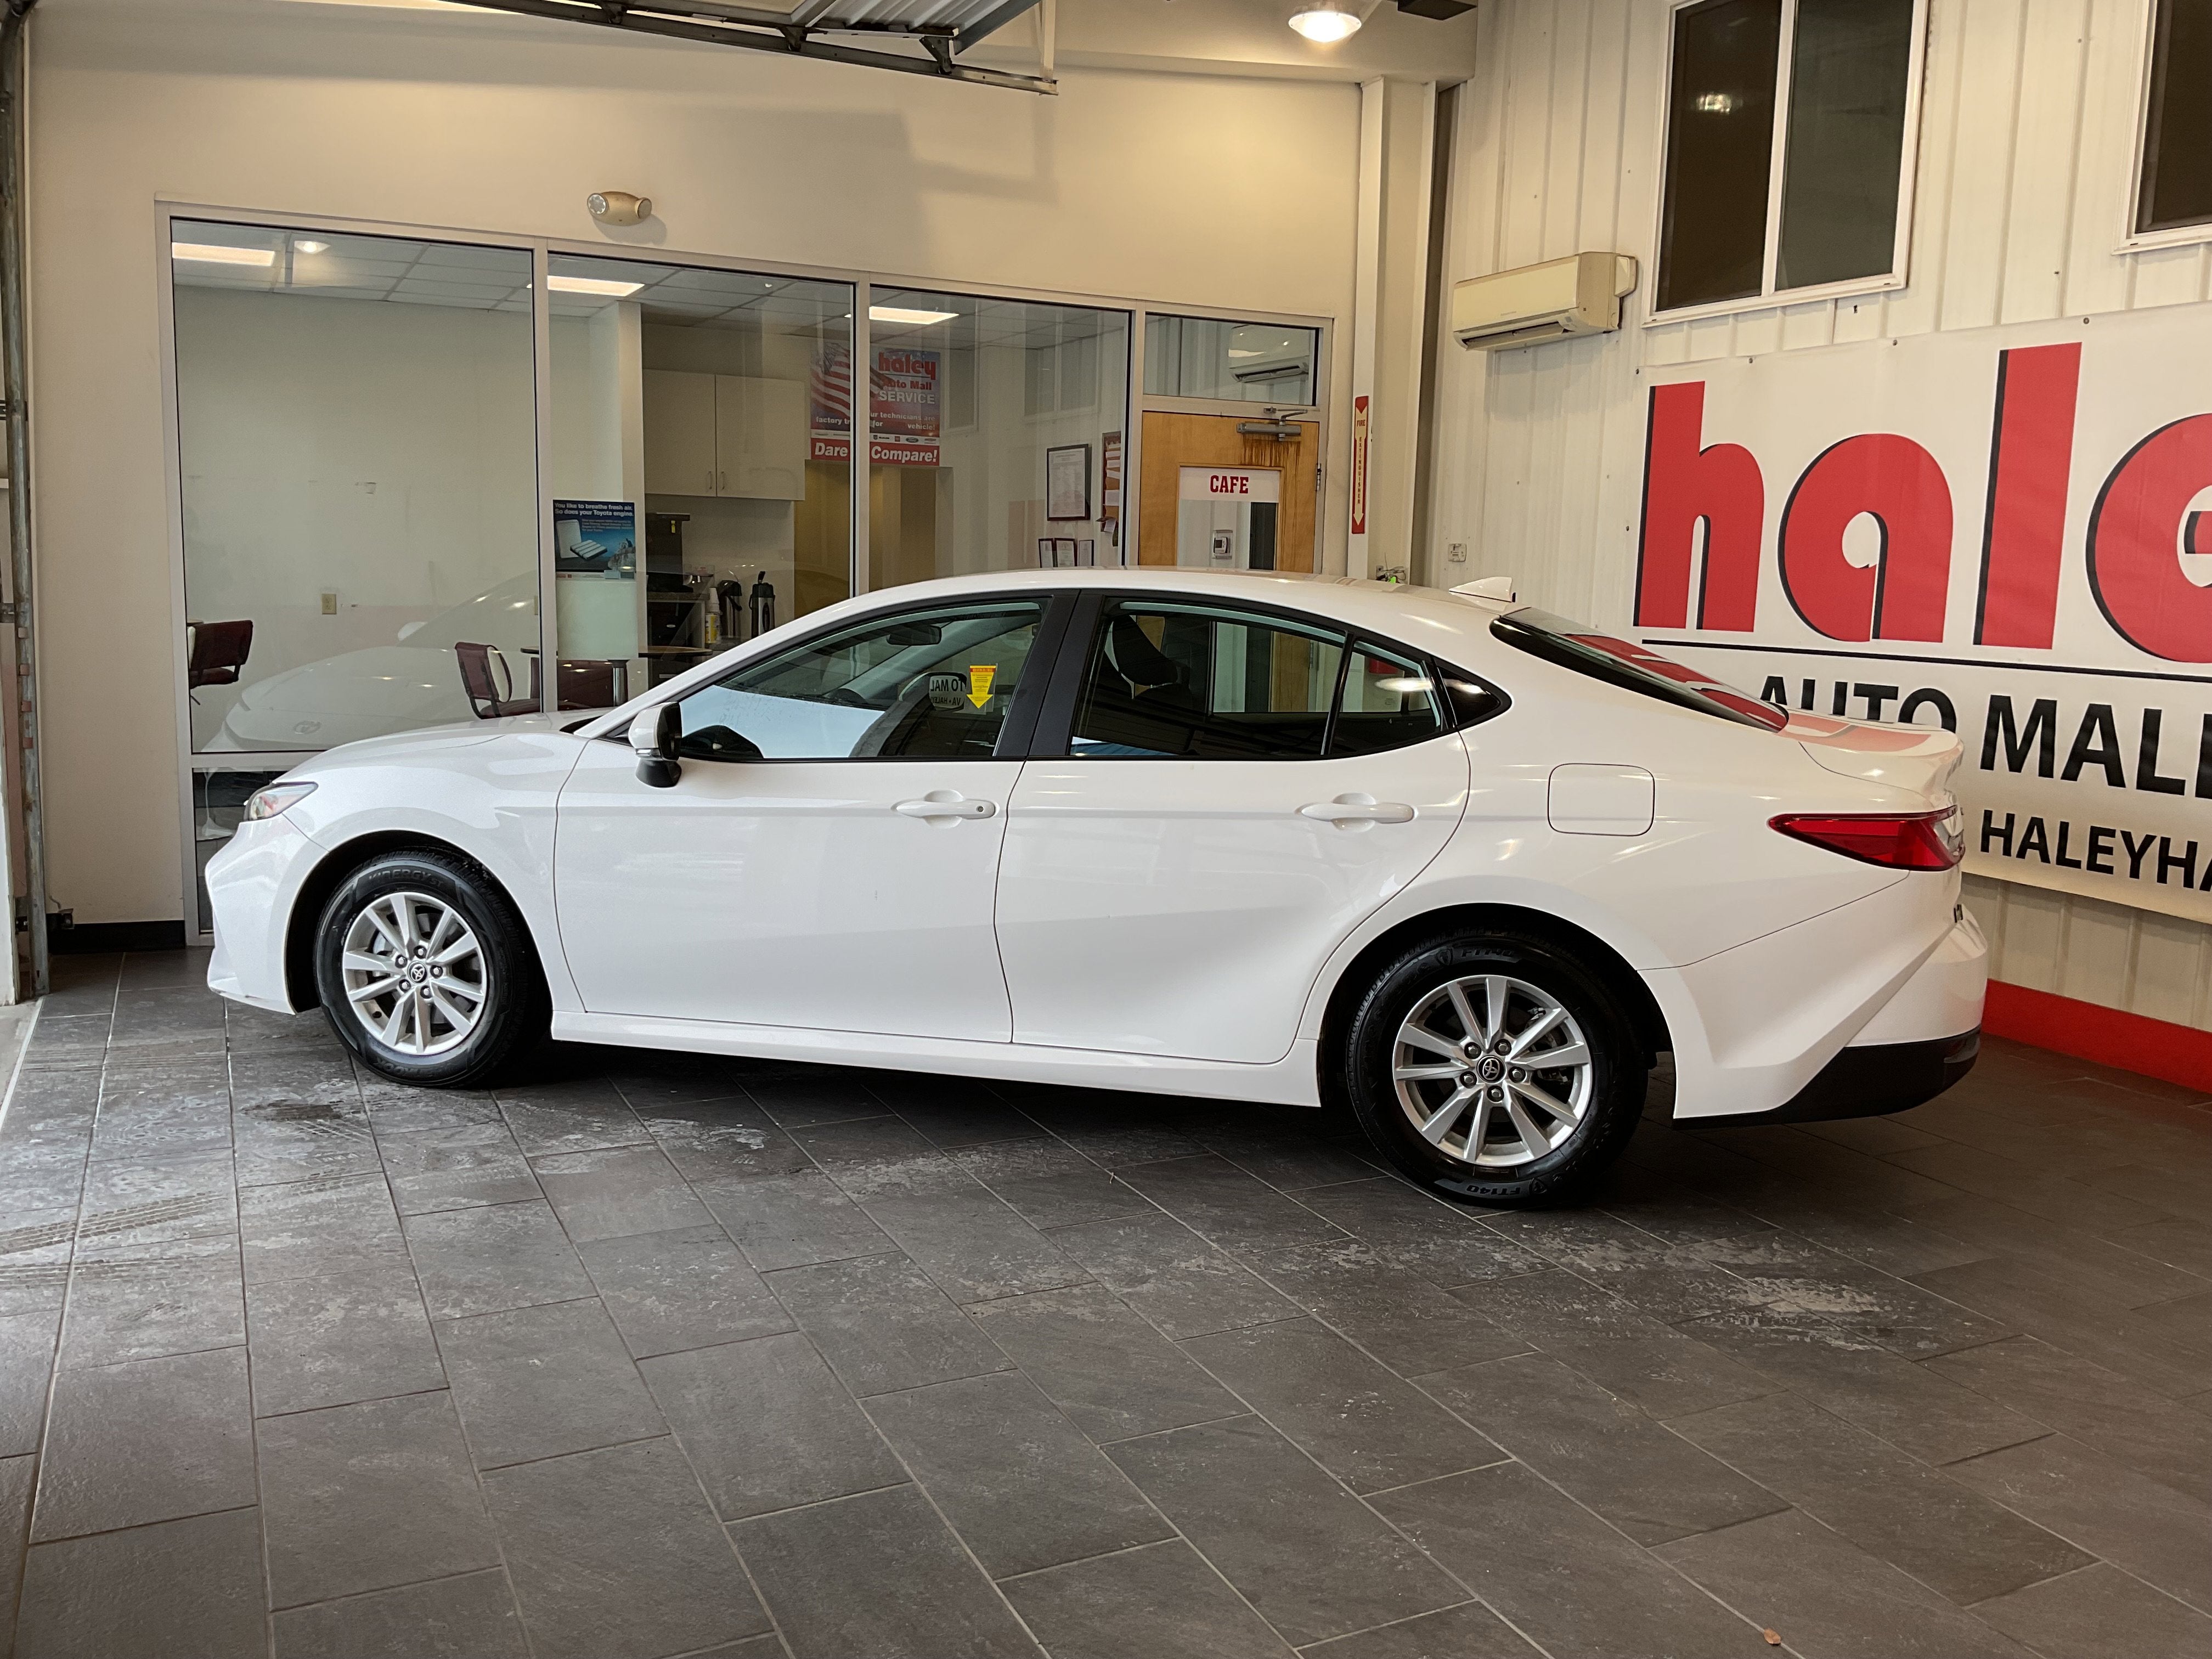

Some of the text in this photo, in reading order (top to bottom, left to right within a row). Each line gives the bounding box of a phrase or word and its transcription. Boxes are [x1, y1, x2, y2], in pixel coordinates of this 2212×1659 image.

[878, 352, 936, 380] haley
[910, 381, 932, 390] Mall
[879, 391, 935, 404] SERVICE
[816, 416, 843, 425] factory
[880, 412, 922, 421] technicians
[815, 442, 938, 464] Dare Compare!
[1210, 475, 1249, 494] CAFE
[1633, 341, 2212, 663] hale
[1980, 809, 2212, 892] HALEYH
[1466, 1184, 1520, 1196] FT140
